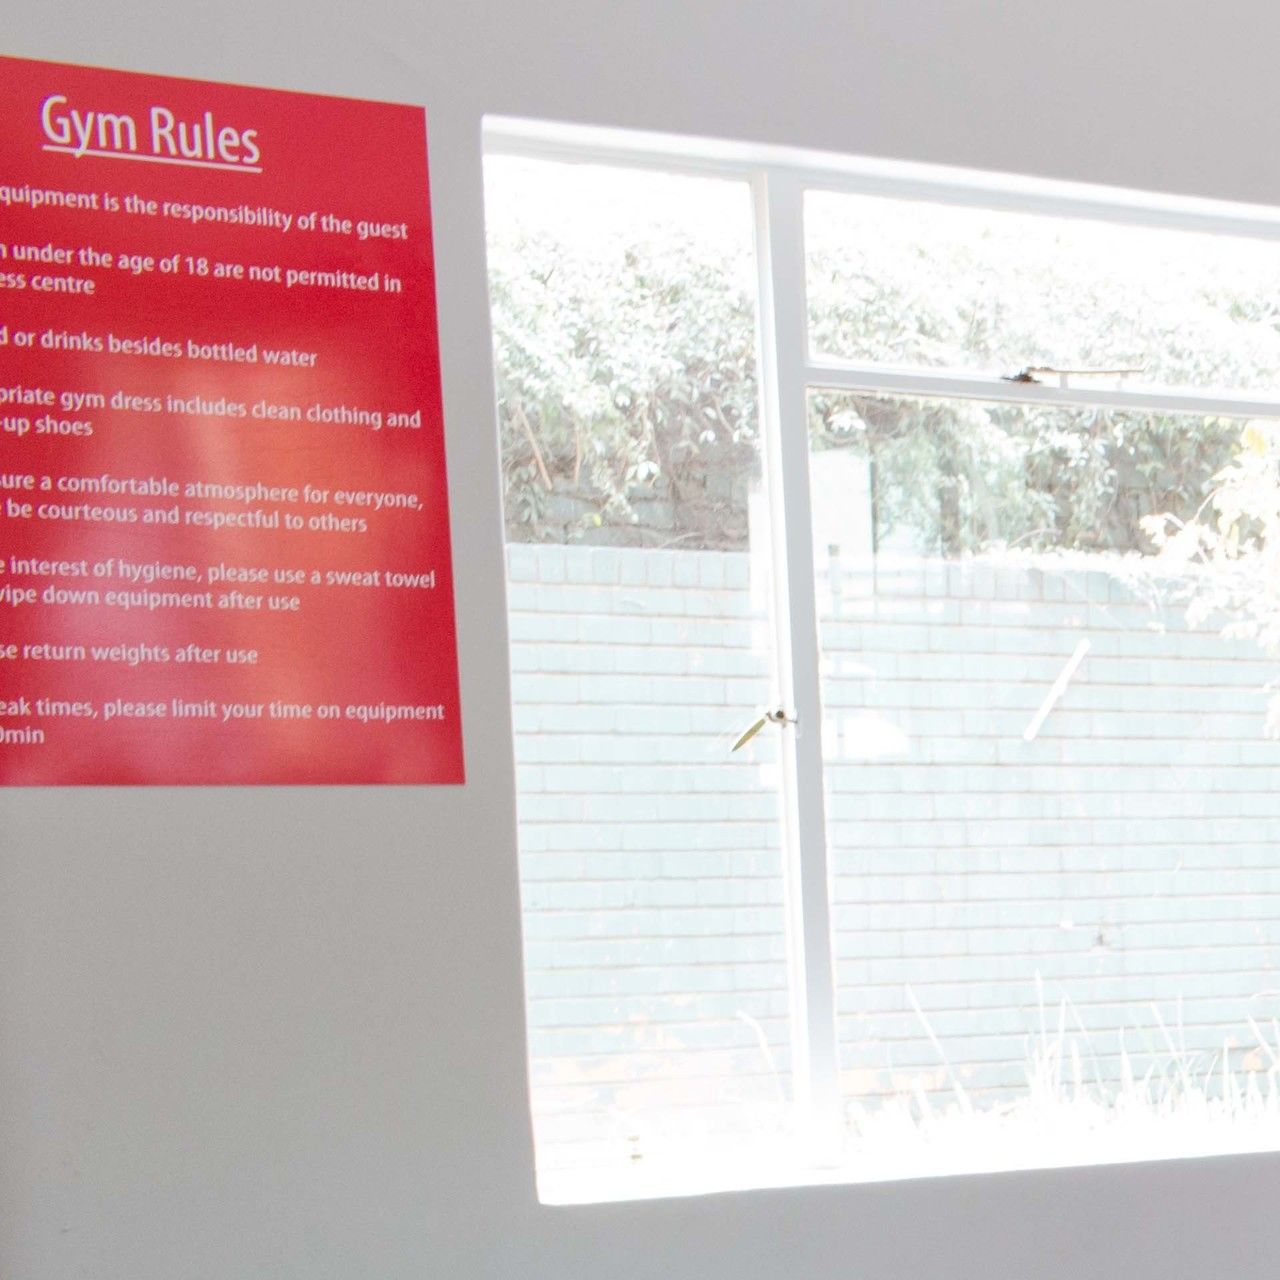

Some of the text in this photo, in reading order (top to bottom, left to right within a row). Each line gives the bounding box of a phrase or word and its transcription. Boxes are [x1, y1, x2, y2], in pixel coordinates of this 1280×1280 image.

[41, 95, 261, 164] Gym Rules
[104, 192, 120, 212] is
[124, 194, 158, 216] the
[163, 202, 293, 231] responsibility
[297, 212, 317, 231] of
[320, 213, 353, 234] the
[356, 221, 408, 240] guest
[13, 243, 74, 263] under
[78, 246, 113, 268] the
[118, 254, 155, 275] age
[159, 254, 180, 274] of
[185, 256, 209, 276] 18
[213, 263, 244, 280] are
[248, 266, 282, 283] not
[286, 269, 380, 292] permitted
[383, 273, 402, 294] in
[31, 276, 95, 295] centre
[13, 331, 36, 347] or
[40, 329, 103, 352] drinks
[108, 333, 182, 357] besides
[188, 339, 257, 362] bottled
[263, 350, 317, 367] water
[35, 415, 93, 436] shoes
[60, 392, 105, 411] gym
[111, 391, 161, 412] dress
[167, 395, 246, 417] includes
[252, 400, 301, 420] clean
[306, 404, 382, 430] clothing
[387, 410, 421, 429] and
[40, 476, 52, 490] a
[57, 474, 179, 495] comfortable
[185, 482, 298, 502] atmosphere
[303, 484, 329, 502] for
[334, 491, 423, 510] everyone,
[7, 498, 32, 518] be
[38, 505, 137, 522] courteous
[143, 507, 179, 524] and
[186, 511, 279, 530] respectful
[285, 514, 304, 529] to
[308, 514, 367, 532] others
[11, 556, 87, 575] interest
[94, 559, 113, 576] of
[119, 560, 201, 581] hygiene,
[208, 563, 269, 583] please
[274, 570, 305, 583] use
[310, 571, 321, 584] a
[326, 571, 380, 586] sweat
[385, 570, 435, 588] towel
[43, 586, 99, 604] down
[105, 592, 213, 610] equipment
[218, 592, 262, 609] after
[268, 597, 300, 610] use
[23, 644, 85, 660] return
[91, 644, 170, 666] weights
[175, 644, 220, 662] after
[226, 650, 258, 664] use
[36, 698, 98, 718] times,
[104, 699, 167, 720] please
[172, 699, 216, 717] limit
[222, 704, 264, 721] your
[269, 701, 312, 718] time
[317, 705, 340, 718] on
[345, 702, 445, 723] equipment
